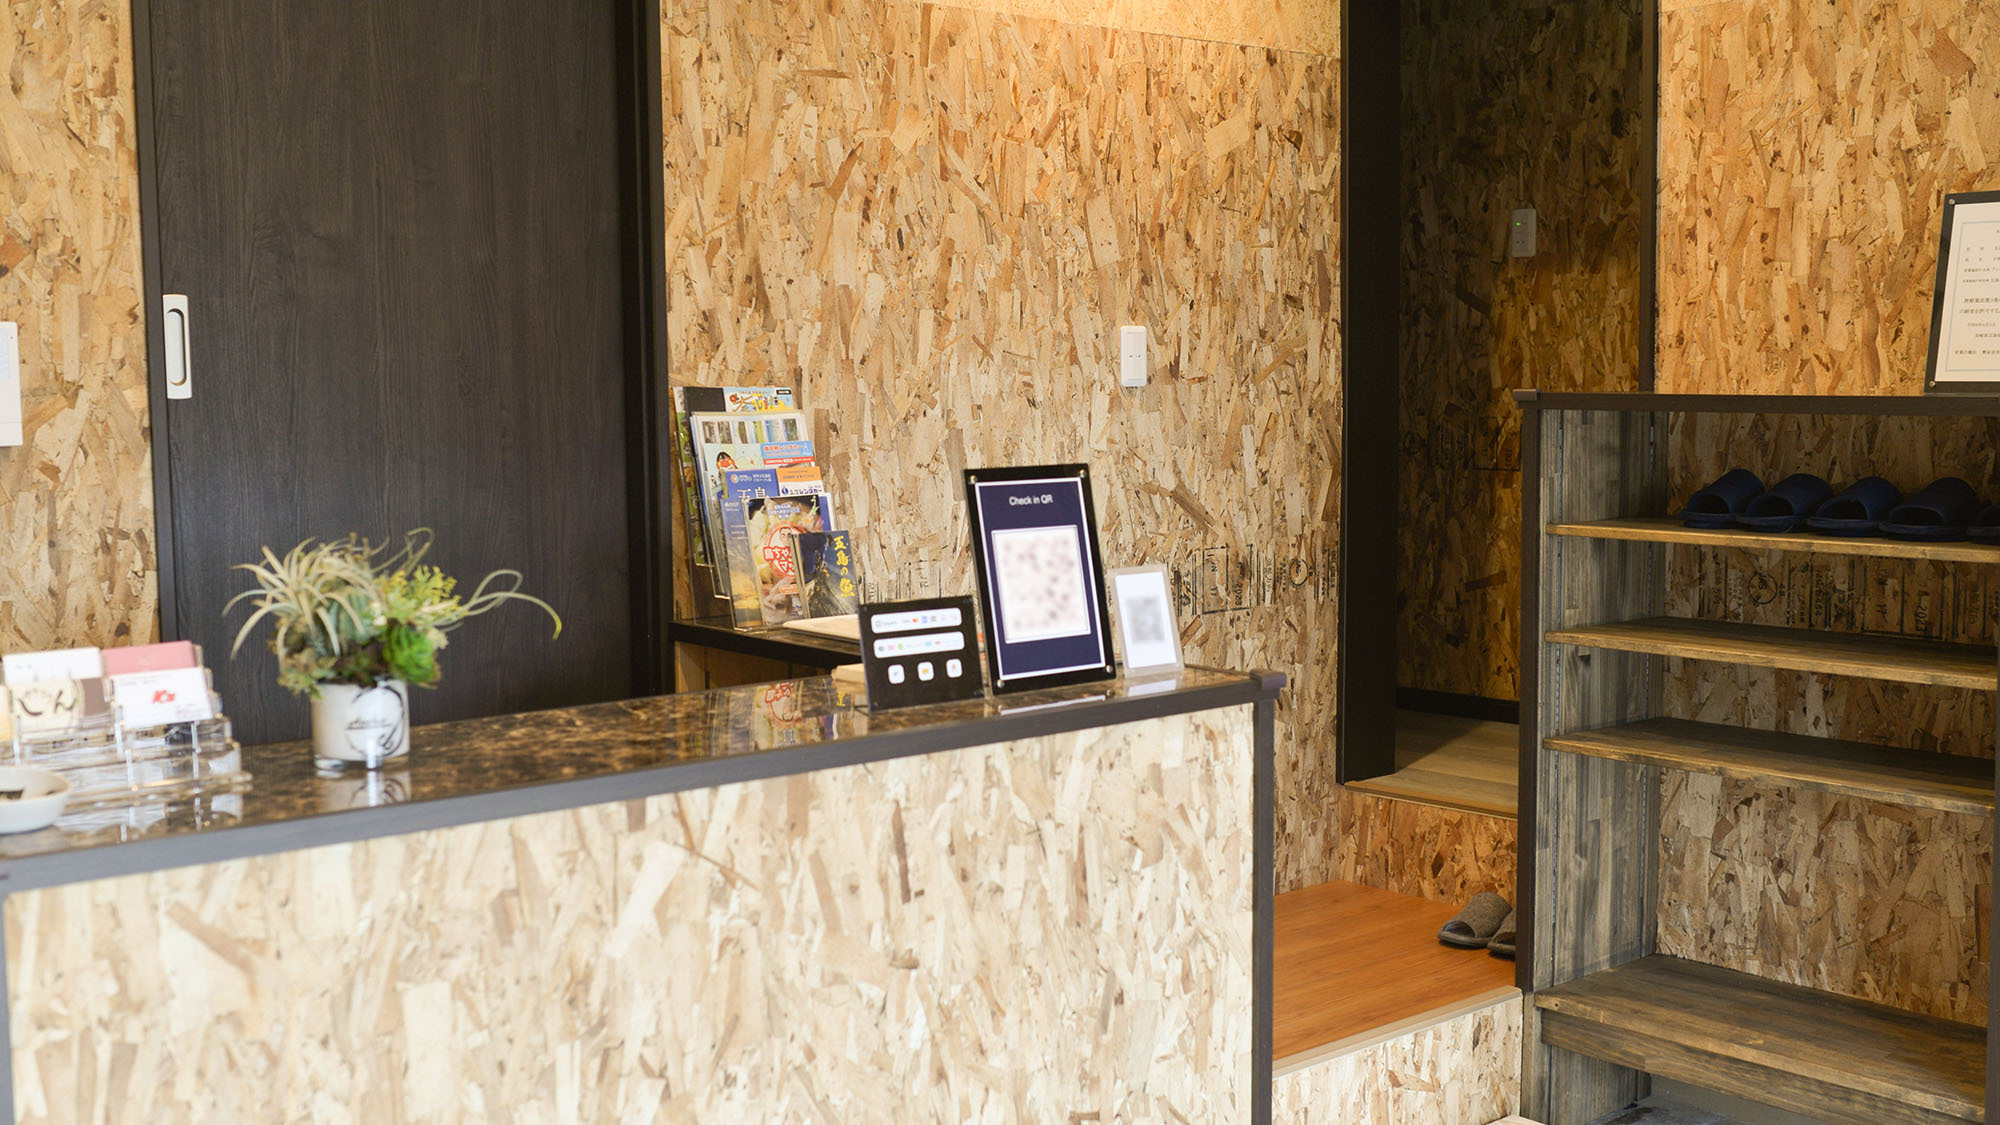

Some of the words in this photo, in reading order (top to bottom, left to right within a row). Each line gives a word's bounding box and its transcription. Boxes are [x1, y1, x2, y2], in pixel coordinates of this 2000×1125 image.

[1009, 496, 1032, 506] Check
[1033, 495, 1040, 504] in
[1040, 494, 1053, 504] QR
